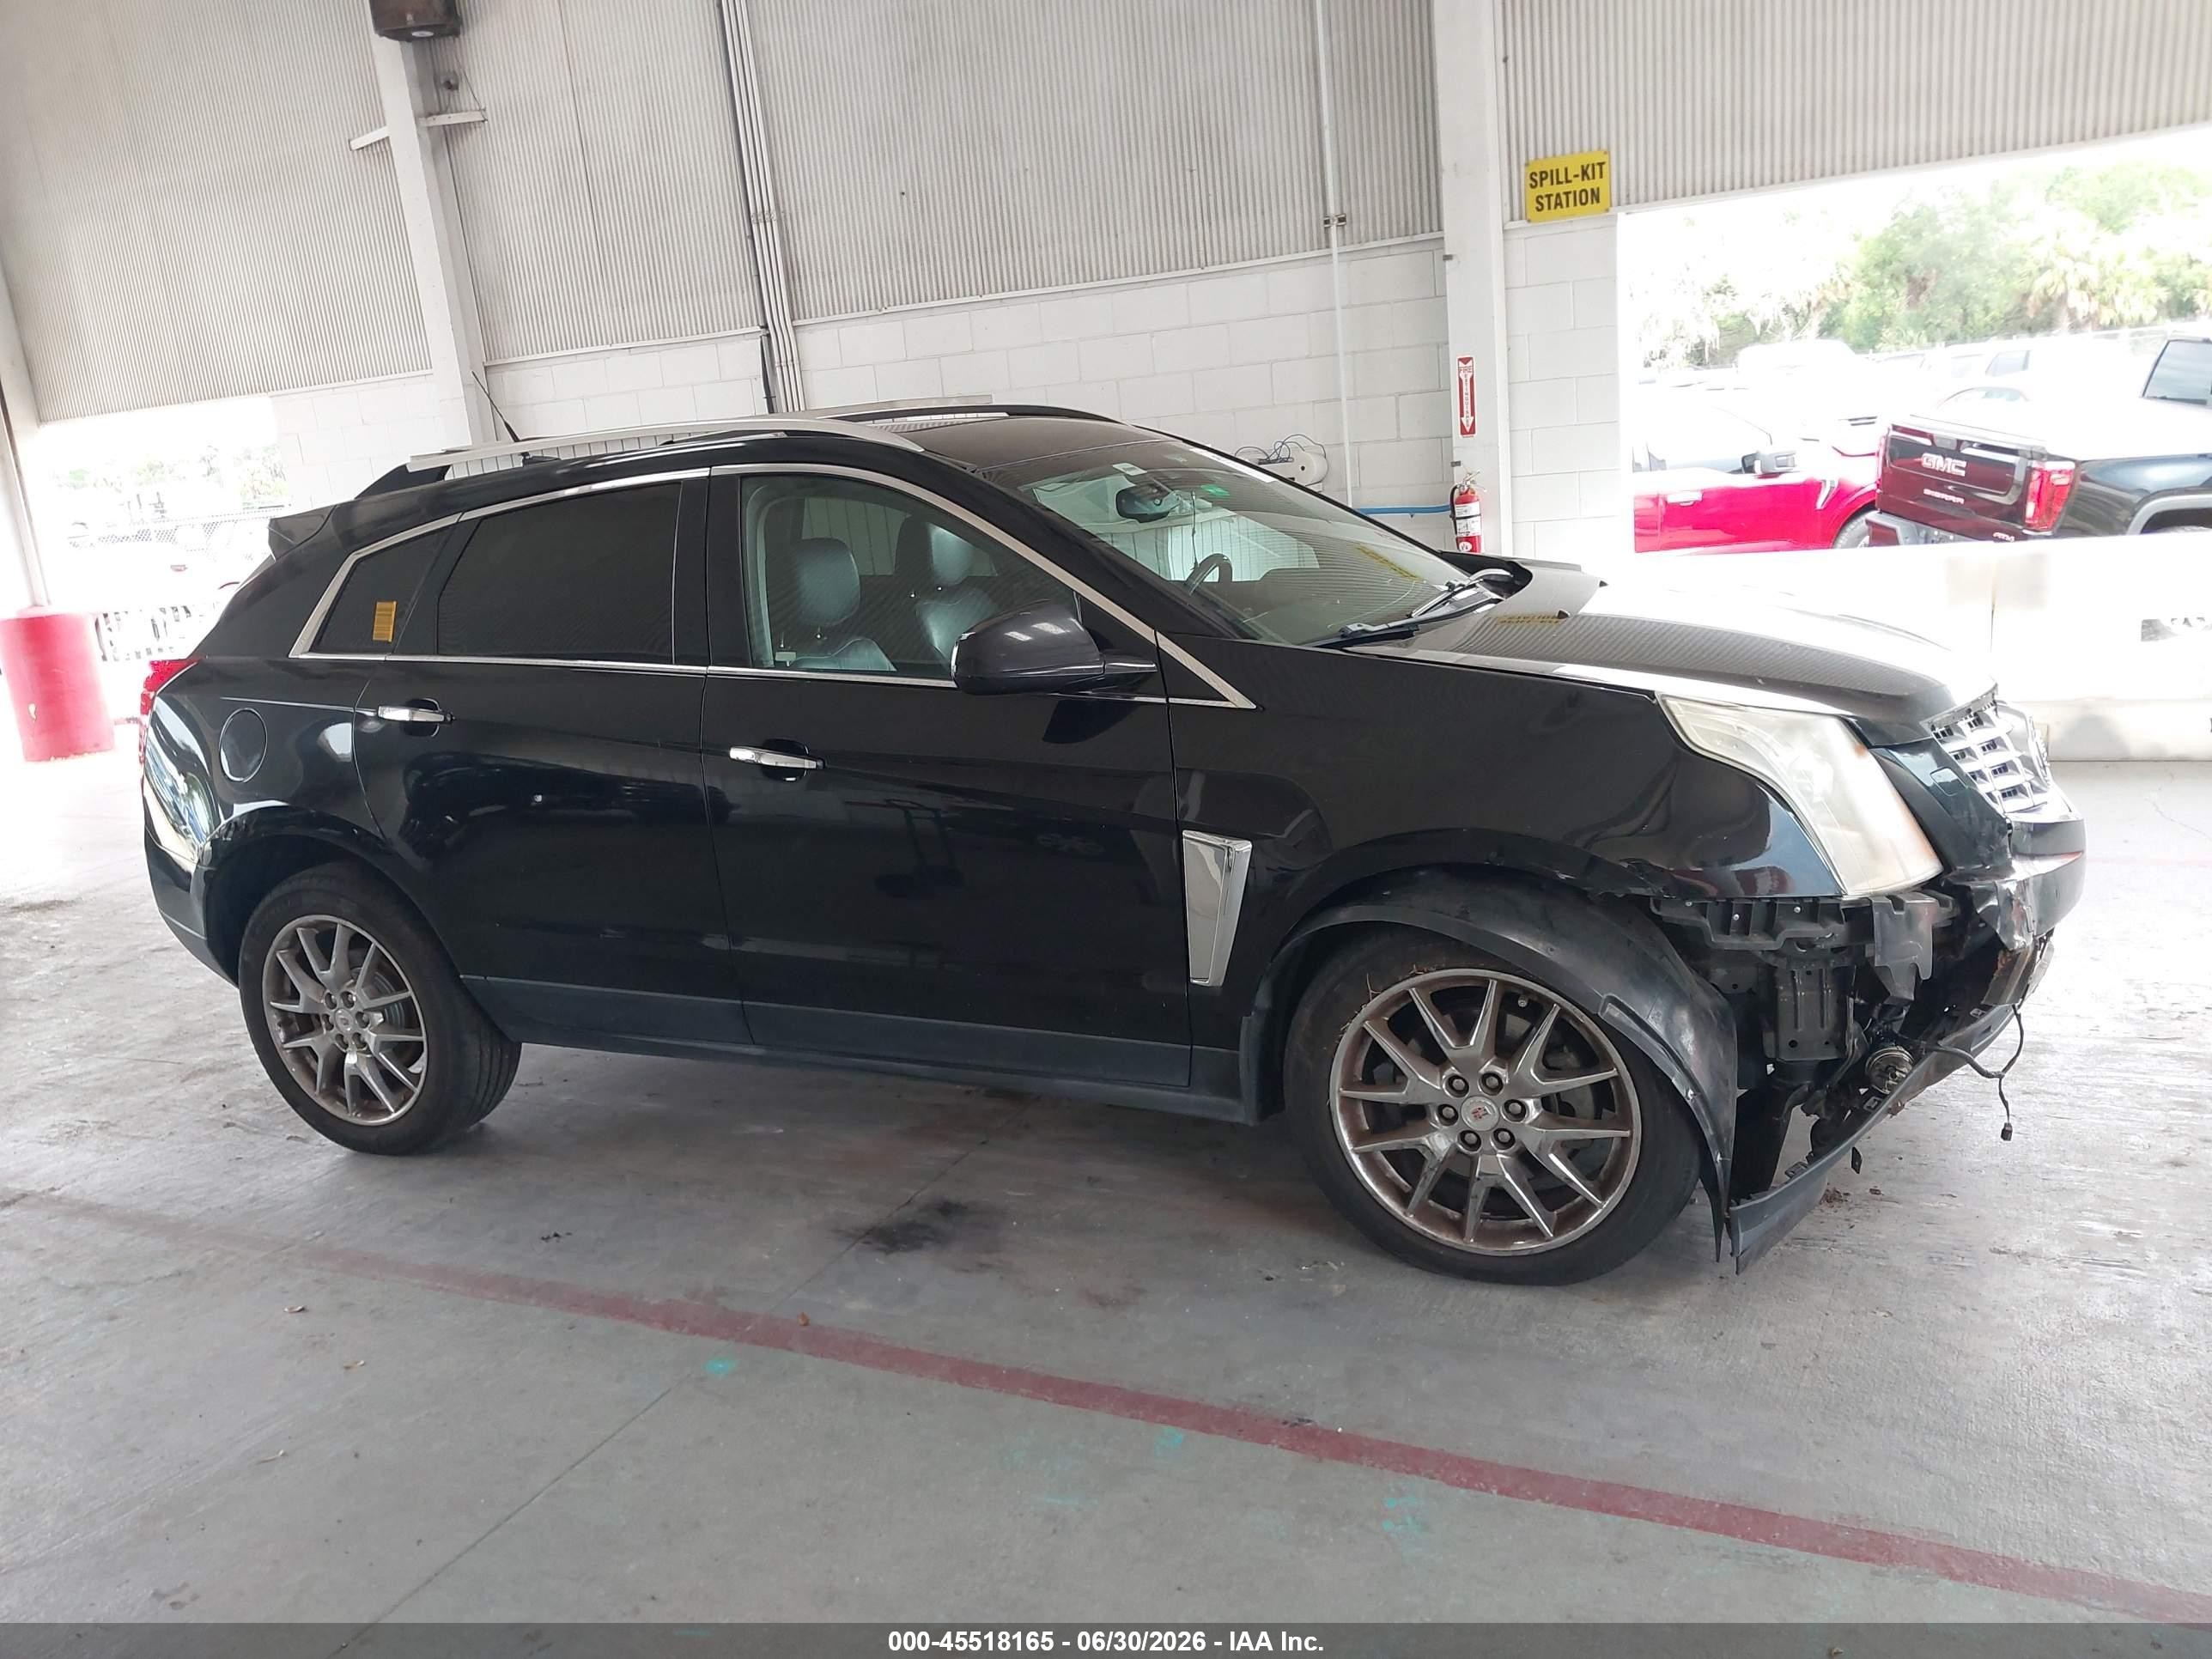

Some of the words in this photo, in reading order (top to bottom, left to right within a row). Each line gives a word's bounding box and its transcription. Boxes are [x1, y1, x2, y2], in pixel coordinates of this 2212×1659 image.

[1528, 161, 1606, 189] SPILL-KIT
[1535, 186, 1600, 212] STATION
[1922, 453, 1967, 477] GMC
